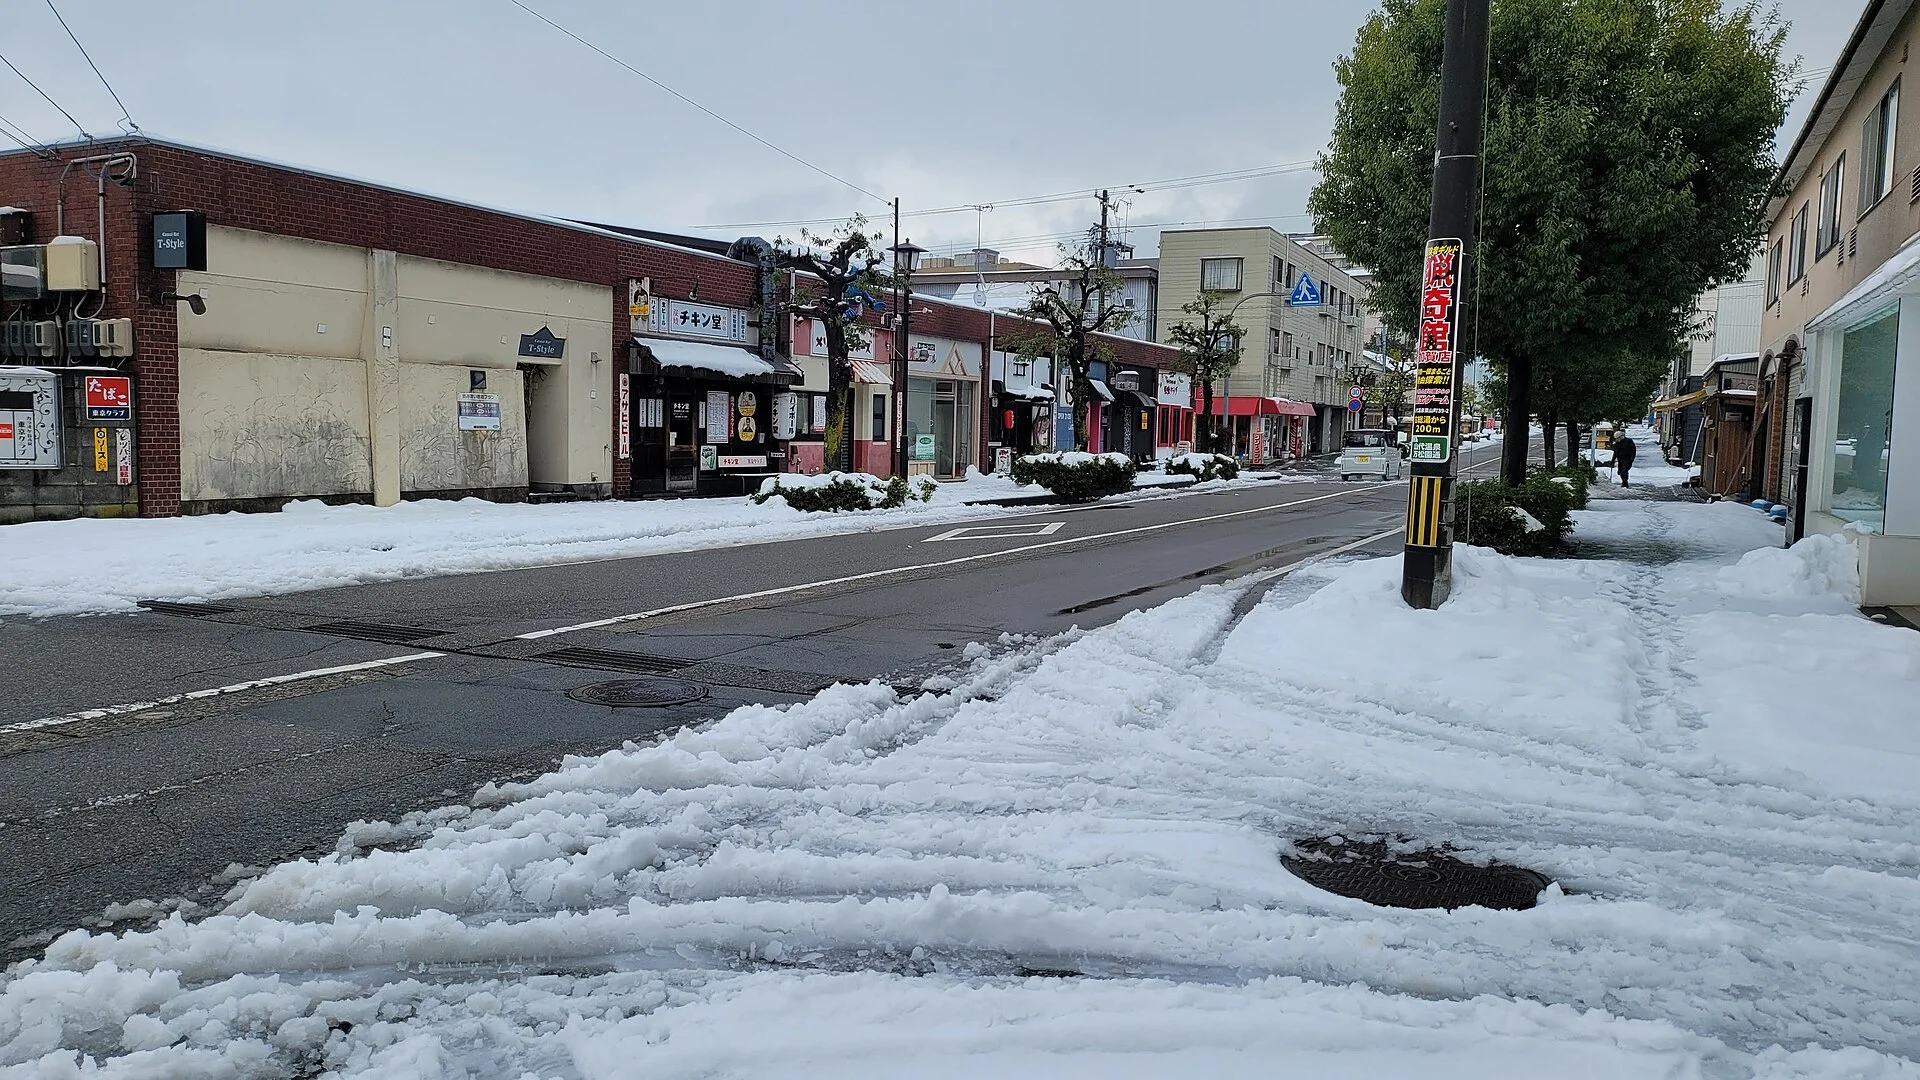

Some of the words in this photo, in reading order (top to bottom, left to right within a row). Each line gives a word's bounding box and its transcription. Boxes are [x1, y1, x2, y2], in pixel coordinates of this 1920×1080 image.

[157, 239, 185, 249] T-Style
[680, 310, 722, 330] チキン堂
[529, 344, 554, 354] T-Style
[89, 379, 127, 405] たばこ
[788, 396, 796, 435] ハイボール
[1415, 425, 1441, 433] 200m
